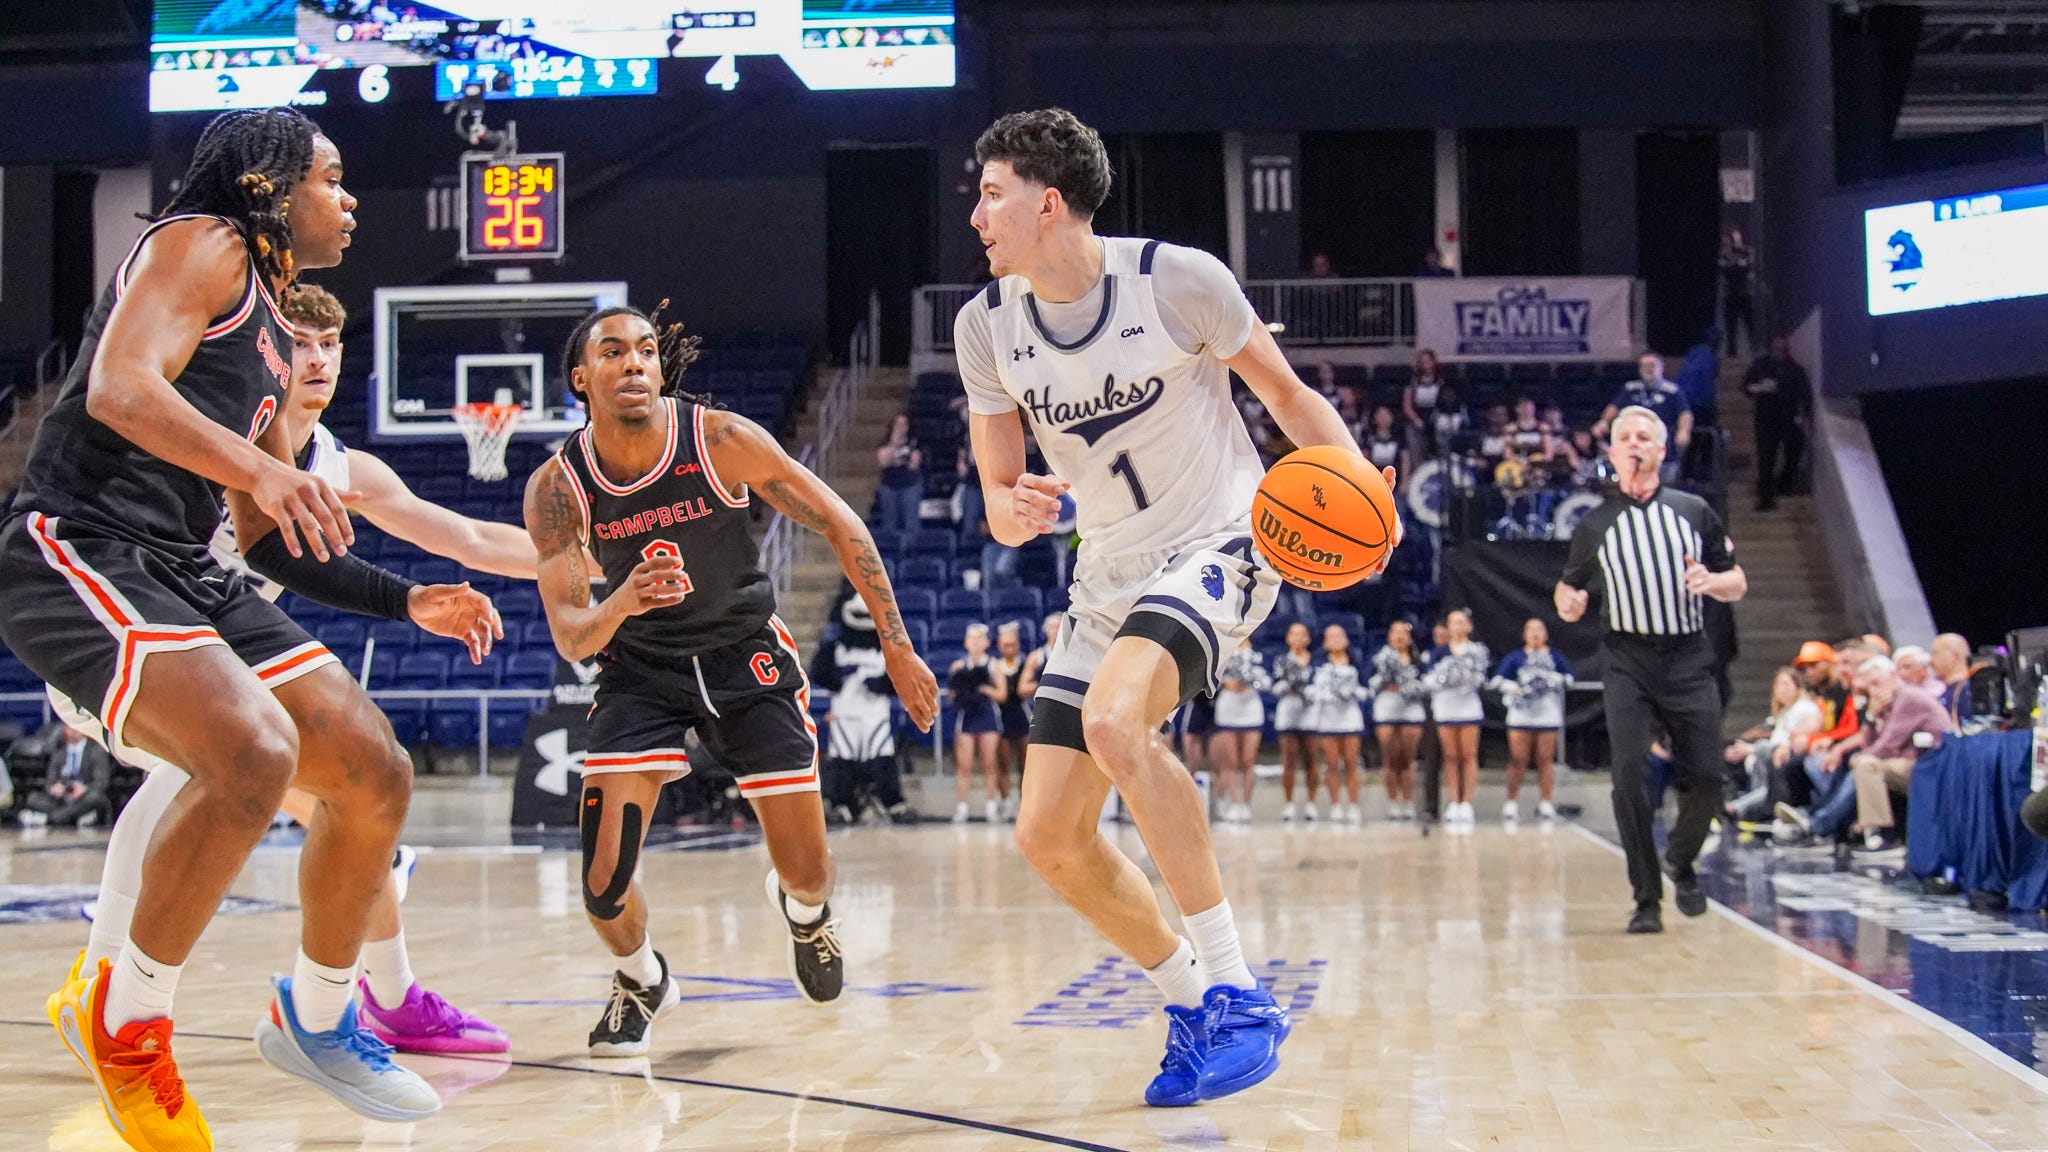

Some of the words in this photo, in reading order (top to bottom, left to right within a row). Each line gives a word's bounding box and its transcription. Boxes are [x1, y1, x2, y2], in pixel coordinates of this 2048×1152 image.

[358, 64, 390, 103] 6
[705, 55, 740, 91] 4
[484, 165, 553, 196] 13:34
[484, 196, 543, 247] 26
[1120, 325, 1145, 338] CAA
[1461, 303, 1586, 336] FAMILY
[1023, 373, 1164, 427] Hawks
[674, 462, 702, 476] CAA
[1108, 449, 1151, 512] 1
[594, 497, 713, 540] CAMPBELL
[1259, 507, 1343, 568] Wilson
[749, 652, 780, 686] C
